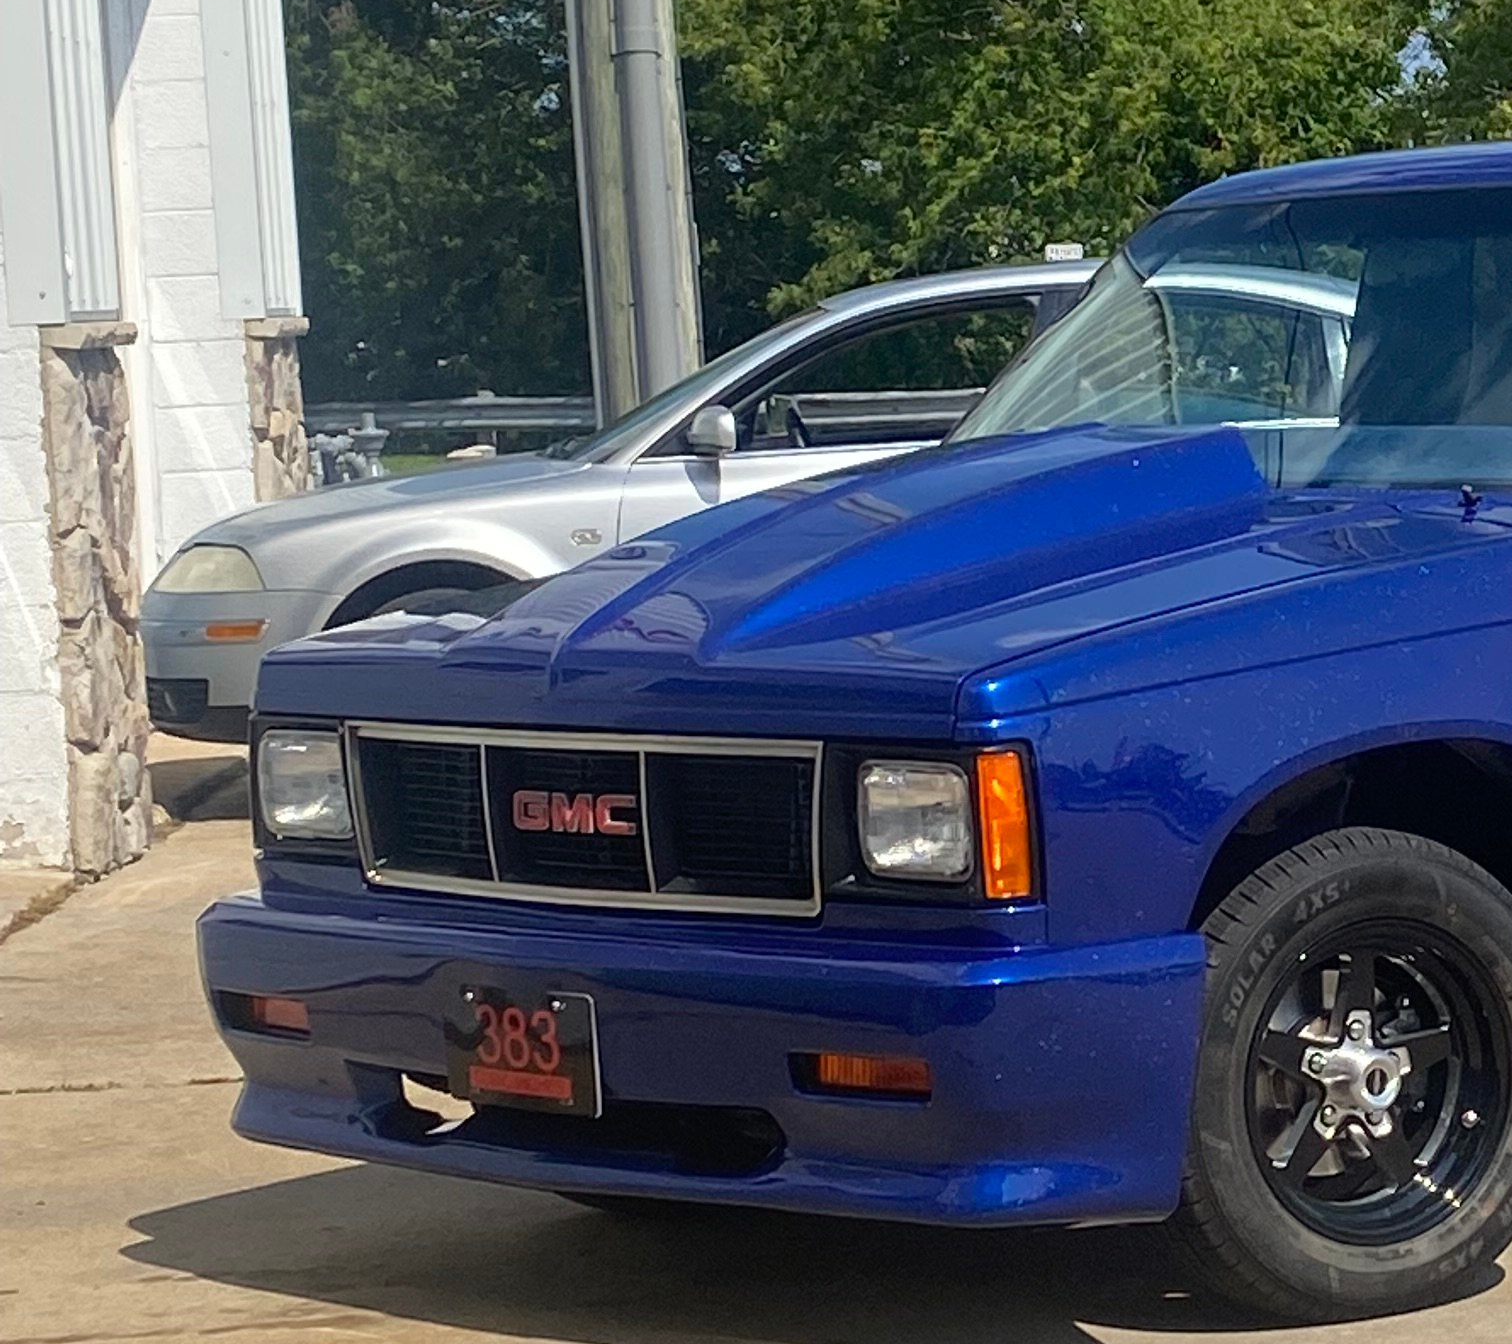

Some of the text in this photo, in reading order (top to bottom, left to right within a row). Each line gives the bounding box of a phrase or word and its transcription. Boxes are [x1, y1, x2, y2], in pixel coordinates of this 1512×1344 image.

[513, 789, 637, 836] GMC
[1222, 932, 1277, 1029] SOLAR
[474, 1003, 561, 1073] 383
